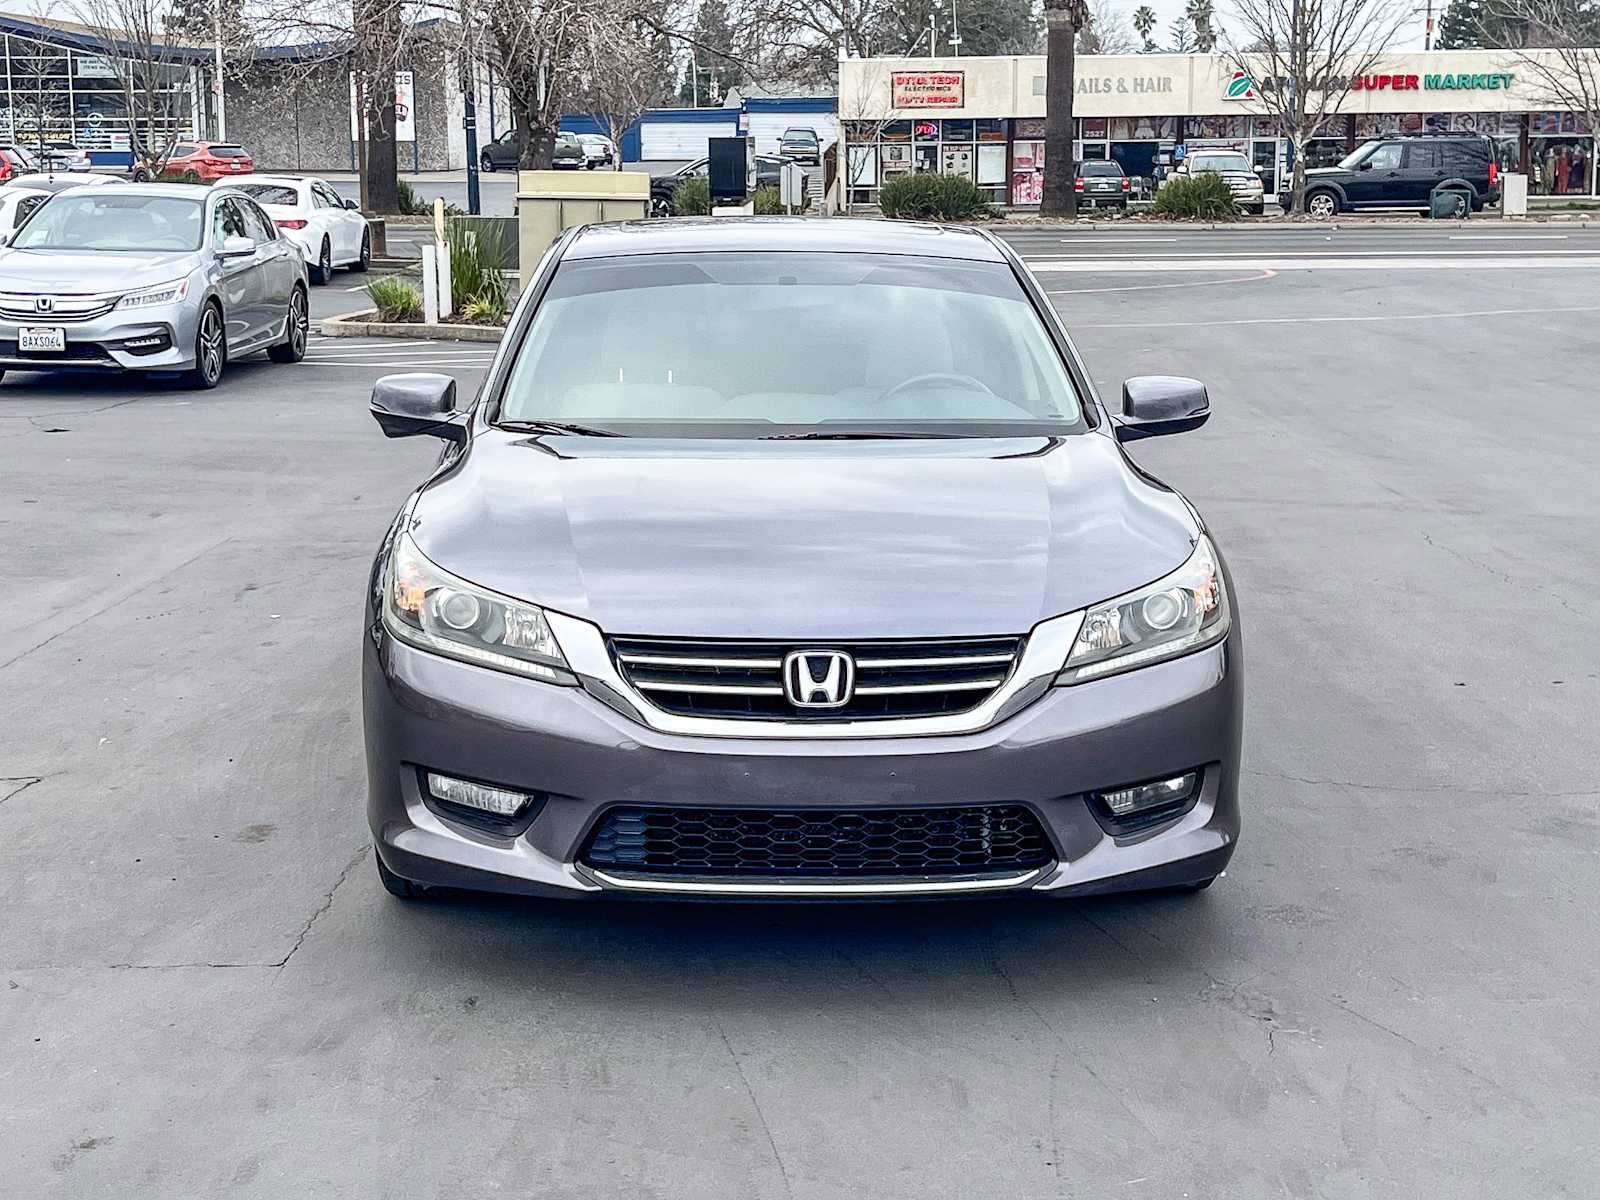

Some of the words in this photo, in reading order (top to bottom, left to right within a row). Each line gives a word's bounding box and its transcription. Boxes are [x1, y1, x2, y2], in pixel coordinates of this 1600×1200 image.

[1074, 78, 1113, 94] AILS
[1116, 77, 1129, 93] &
[1133, 77, 1173, 93] HAIR
[1351, 74, 1420, 91] SUPER
[1424, 74, 1515, 90] MARKET
